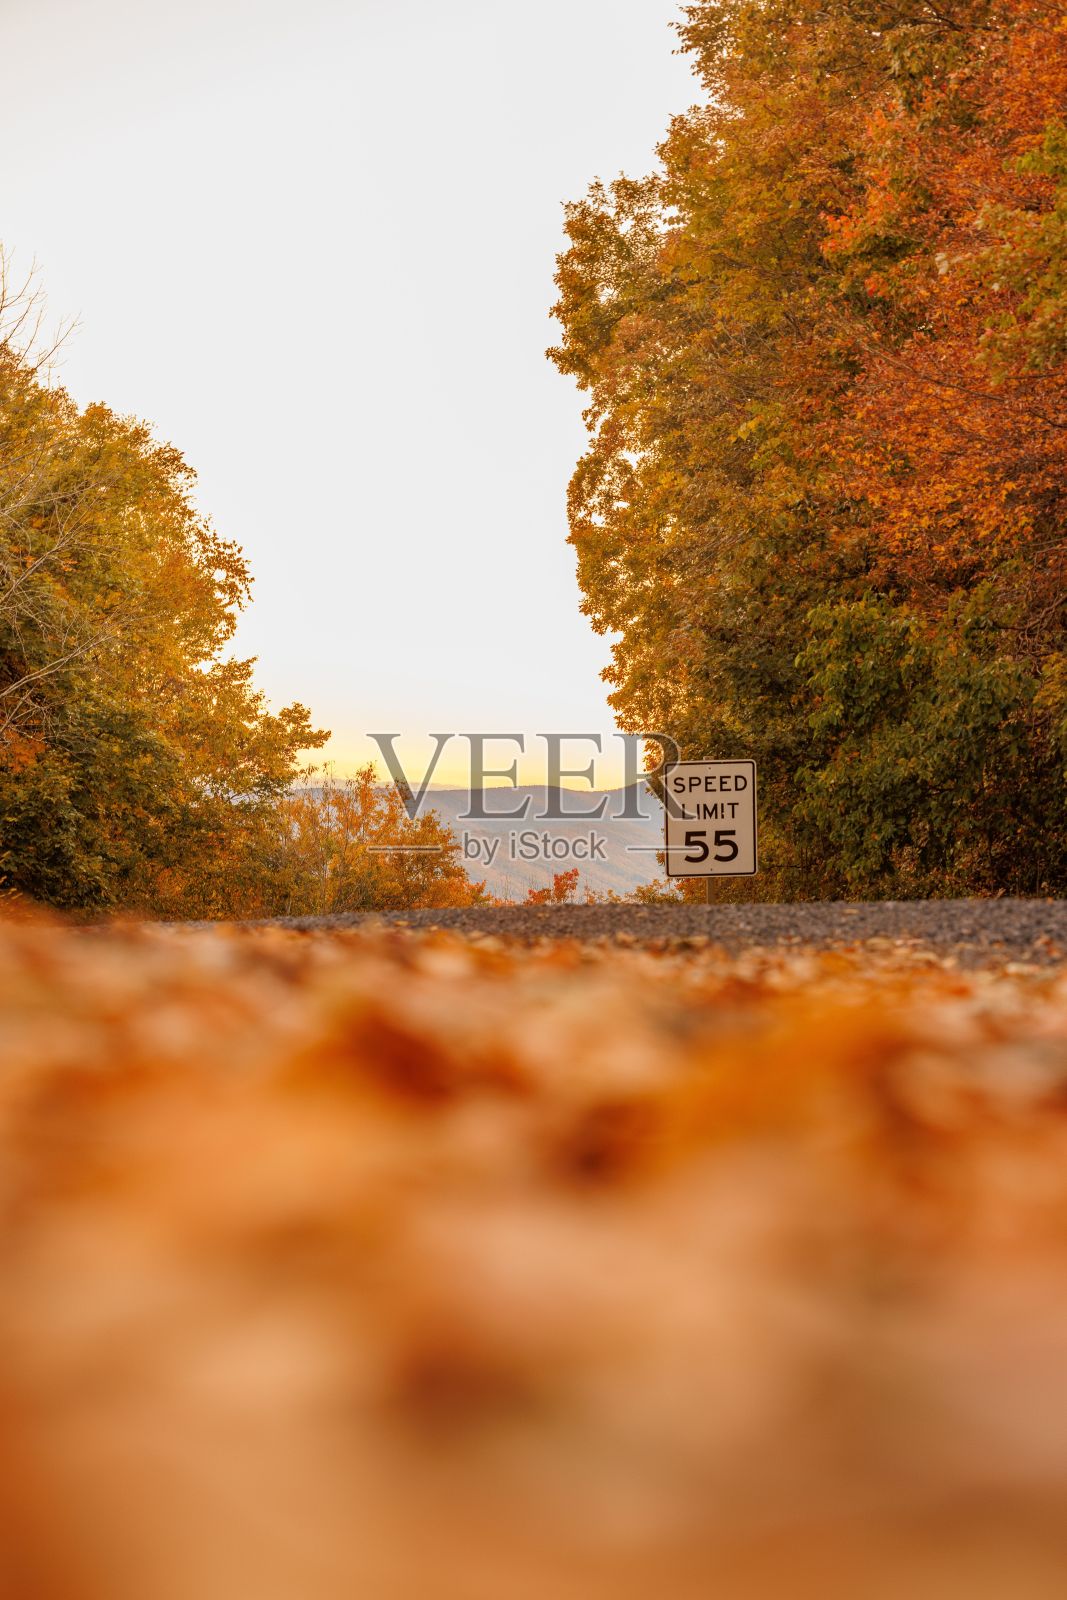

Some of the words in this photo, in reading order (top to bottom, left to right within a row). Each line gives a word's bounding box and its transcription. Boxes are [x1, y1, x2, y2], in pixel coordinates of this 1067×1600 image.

[673, 775, 748, 793] SPEED
[681, 802, 739, 820] LIMIT
[684, 830, 739, 863] 55
